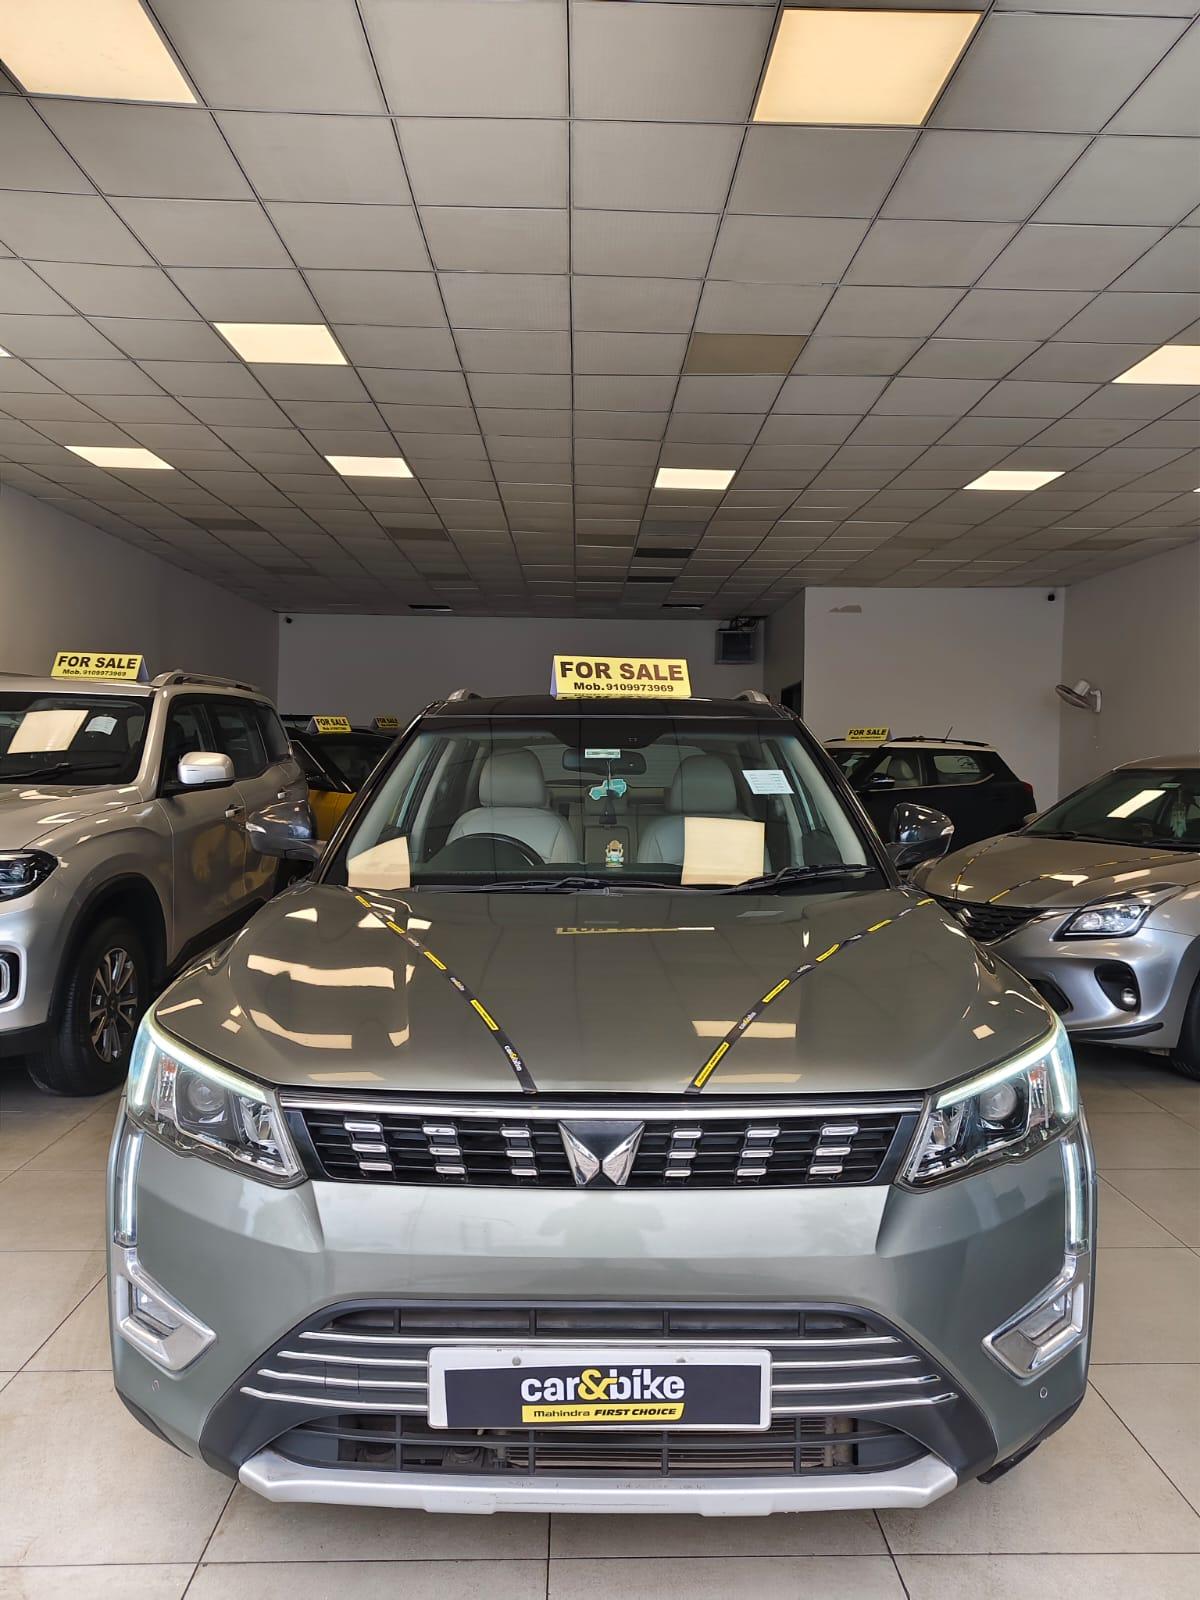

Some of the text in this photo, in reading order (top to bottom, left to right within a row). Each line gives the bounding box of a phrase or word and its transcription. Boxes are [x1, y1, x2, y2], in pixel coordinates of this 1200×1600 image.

[58, 656, 137, 669] FOR SALE
[560, 661, 684, 681] FOR SALE
[316, 718, 348, 726] FOR SALE
[520, 1368, 685, 1402] car&bike
[533, 1408, 677, 1417] Mahindra FIRST CHOICE
